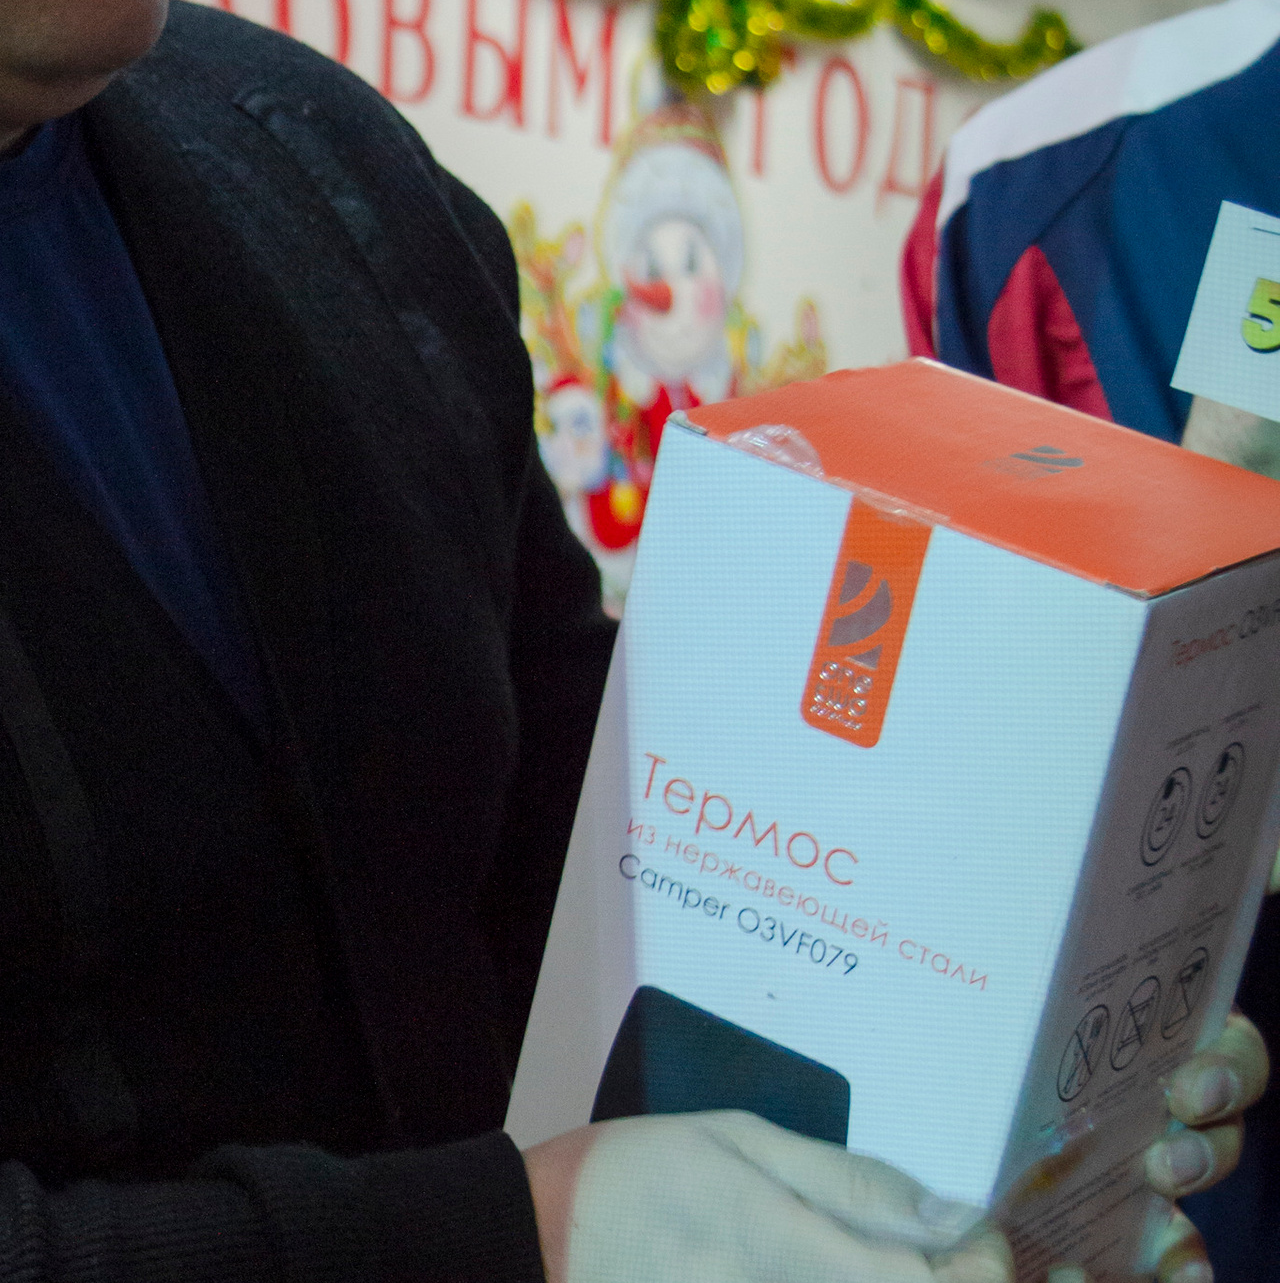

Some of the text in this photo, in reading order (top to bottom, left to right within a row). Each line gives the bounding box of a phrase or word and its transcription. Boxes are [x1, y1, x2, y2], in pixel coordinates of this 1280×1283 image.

[750, 42, 984, 217] ГОД
[619, 854, 731, 920] Camper
[644, 751, 859, 886] Термос
[625, 817, 988, 991] из нержавеющей стали
